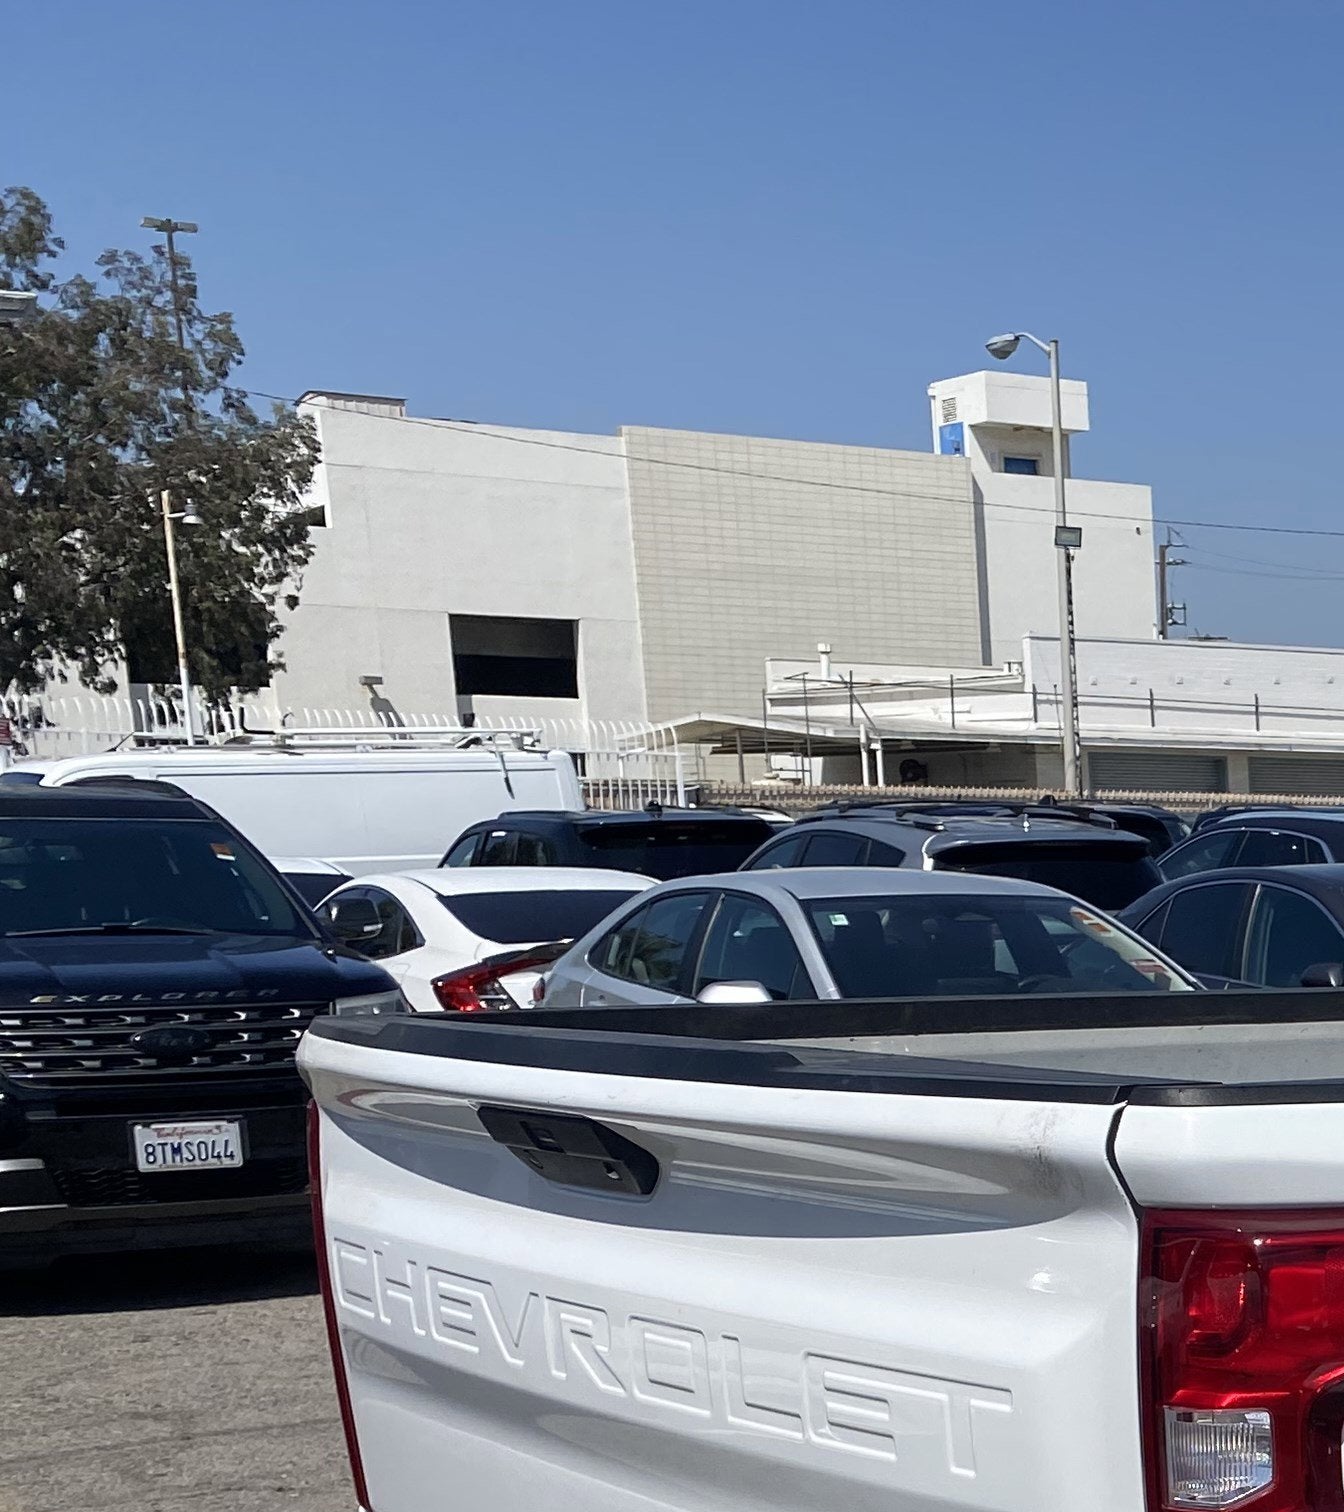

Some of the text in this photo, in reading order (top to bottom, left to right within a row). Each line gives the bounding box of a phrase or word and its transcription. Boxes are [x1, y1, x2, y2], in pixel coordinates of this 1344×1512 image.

[29, 988, 280, 1004] EXPLORER
[143, 1138, 236, 1166] 8TMS044
[331, 1236, 1013, 1480] CHEVROLET
